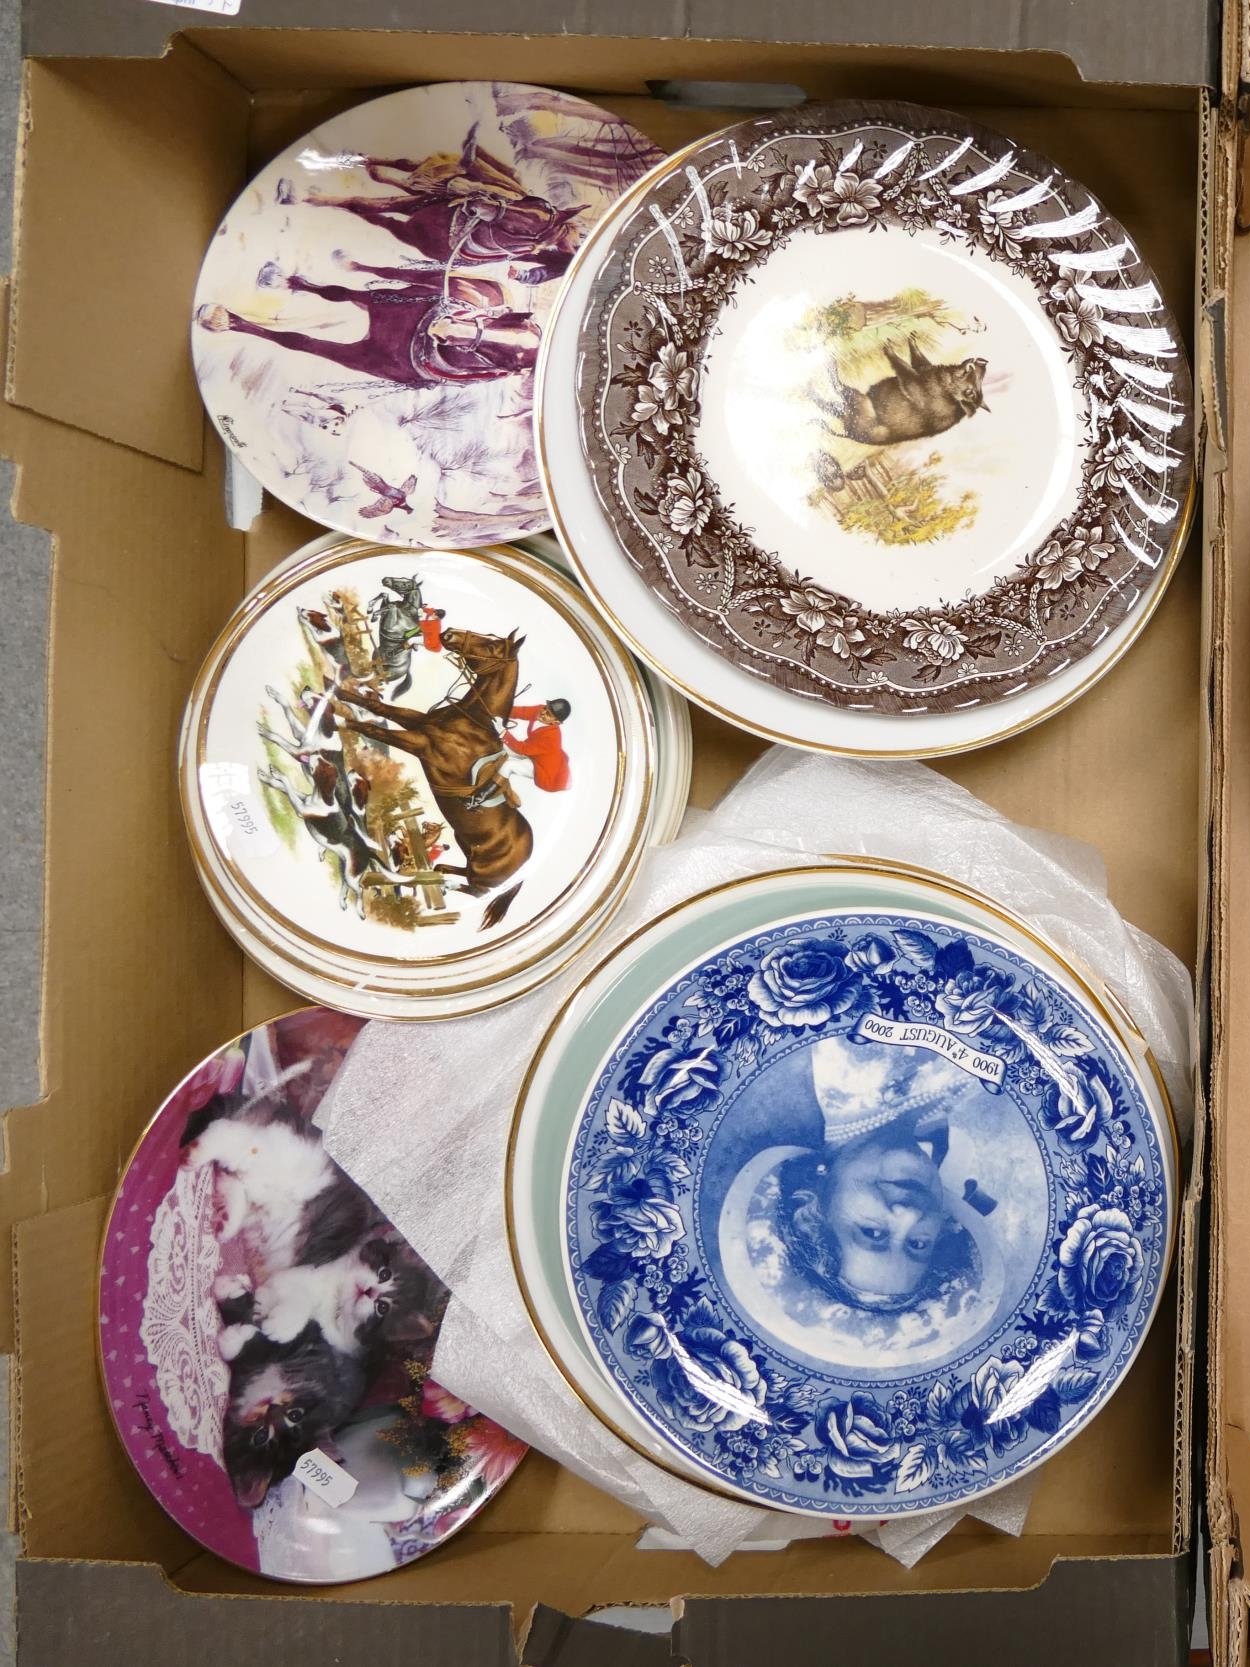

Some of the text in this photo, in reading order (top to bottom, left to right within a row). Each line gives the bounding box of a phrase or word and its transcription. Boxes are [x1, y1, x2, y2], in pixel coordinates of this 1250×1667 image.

[230, 801, 258, 834] 57995
[864, 1019, 894, 1038] 2000
[899, 1028, 956, 1052] AUGUST
[972, 1056, 1000, 1077] 1900
[300, 1459, 334, 1487] 57995
